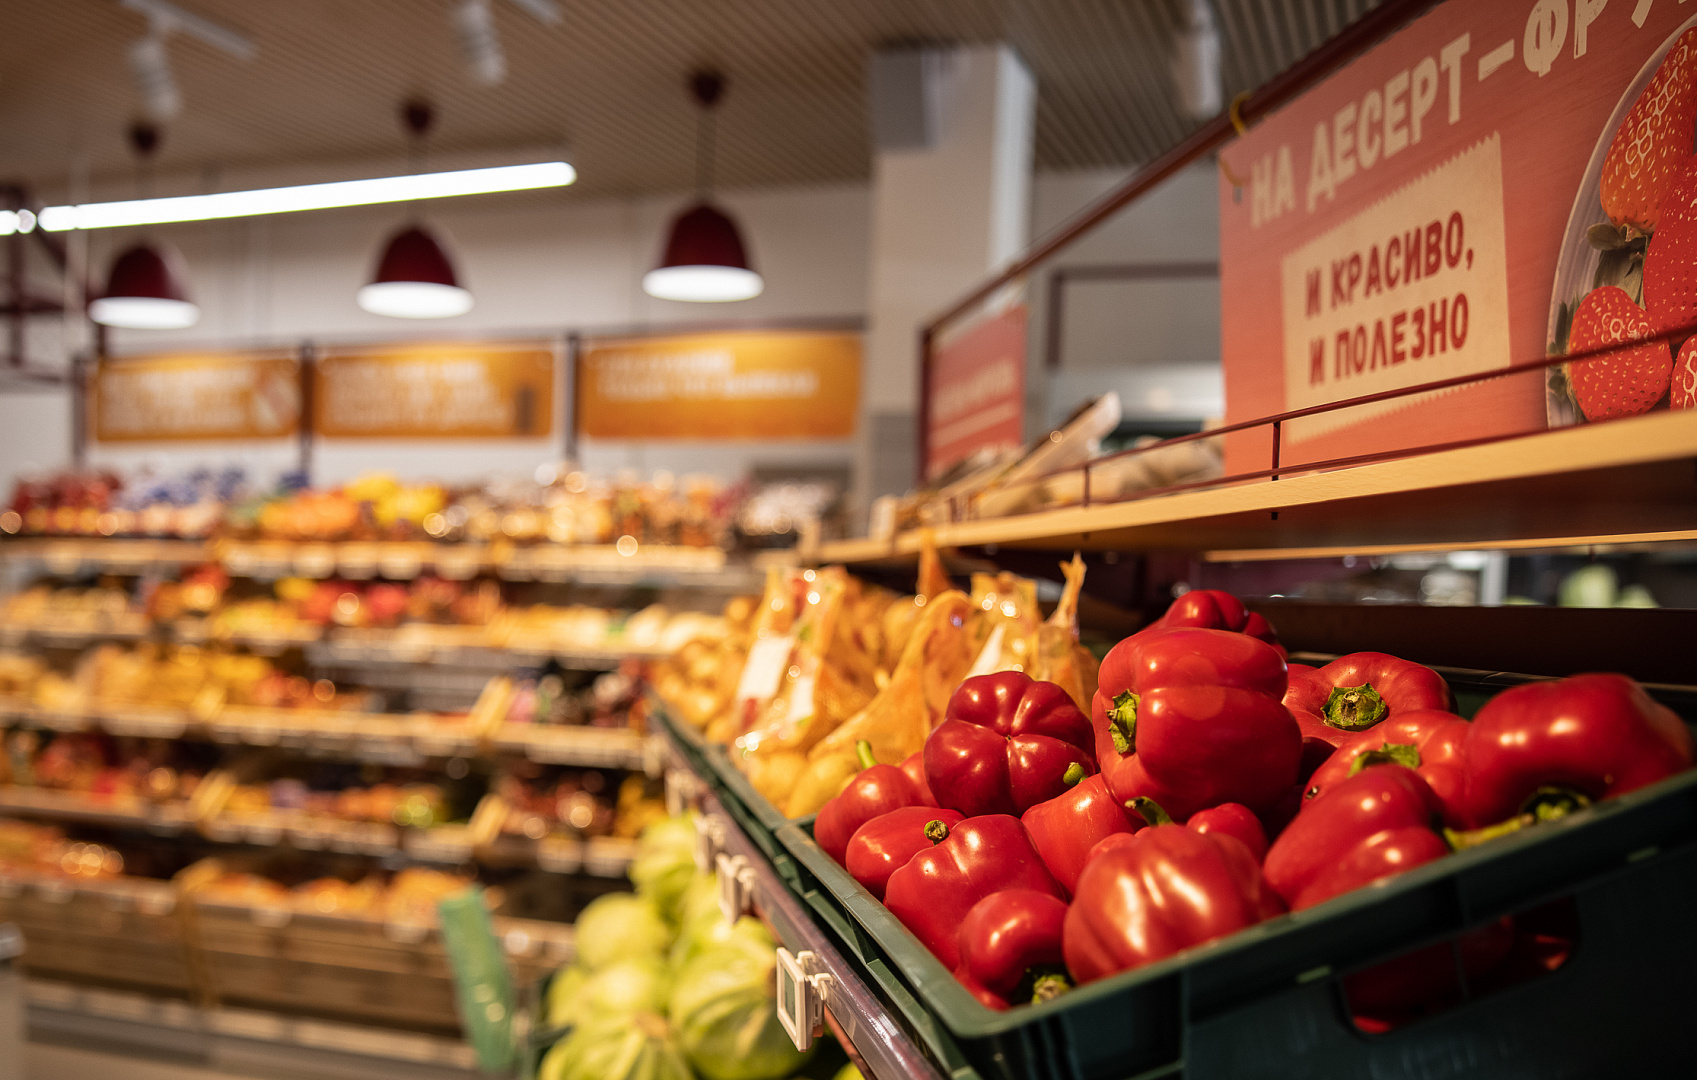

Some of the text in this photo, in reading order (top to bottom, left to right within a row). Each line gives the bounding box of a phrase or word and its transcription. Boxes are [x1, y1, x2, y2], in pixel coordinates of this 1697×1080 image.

[1250, 146, 1296, 229] НА
[1305, 211, 1475, 319] И КРАСИВО,
[1308, 293, 1469, 389] И ПОЛЕЗНО
